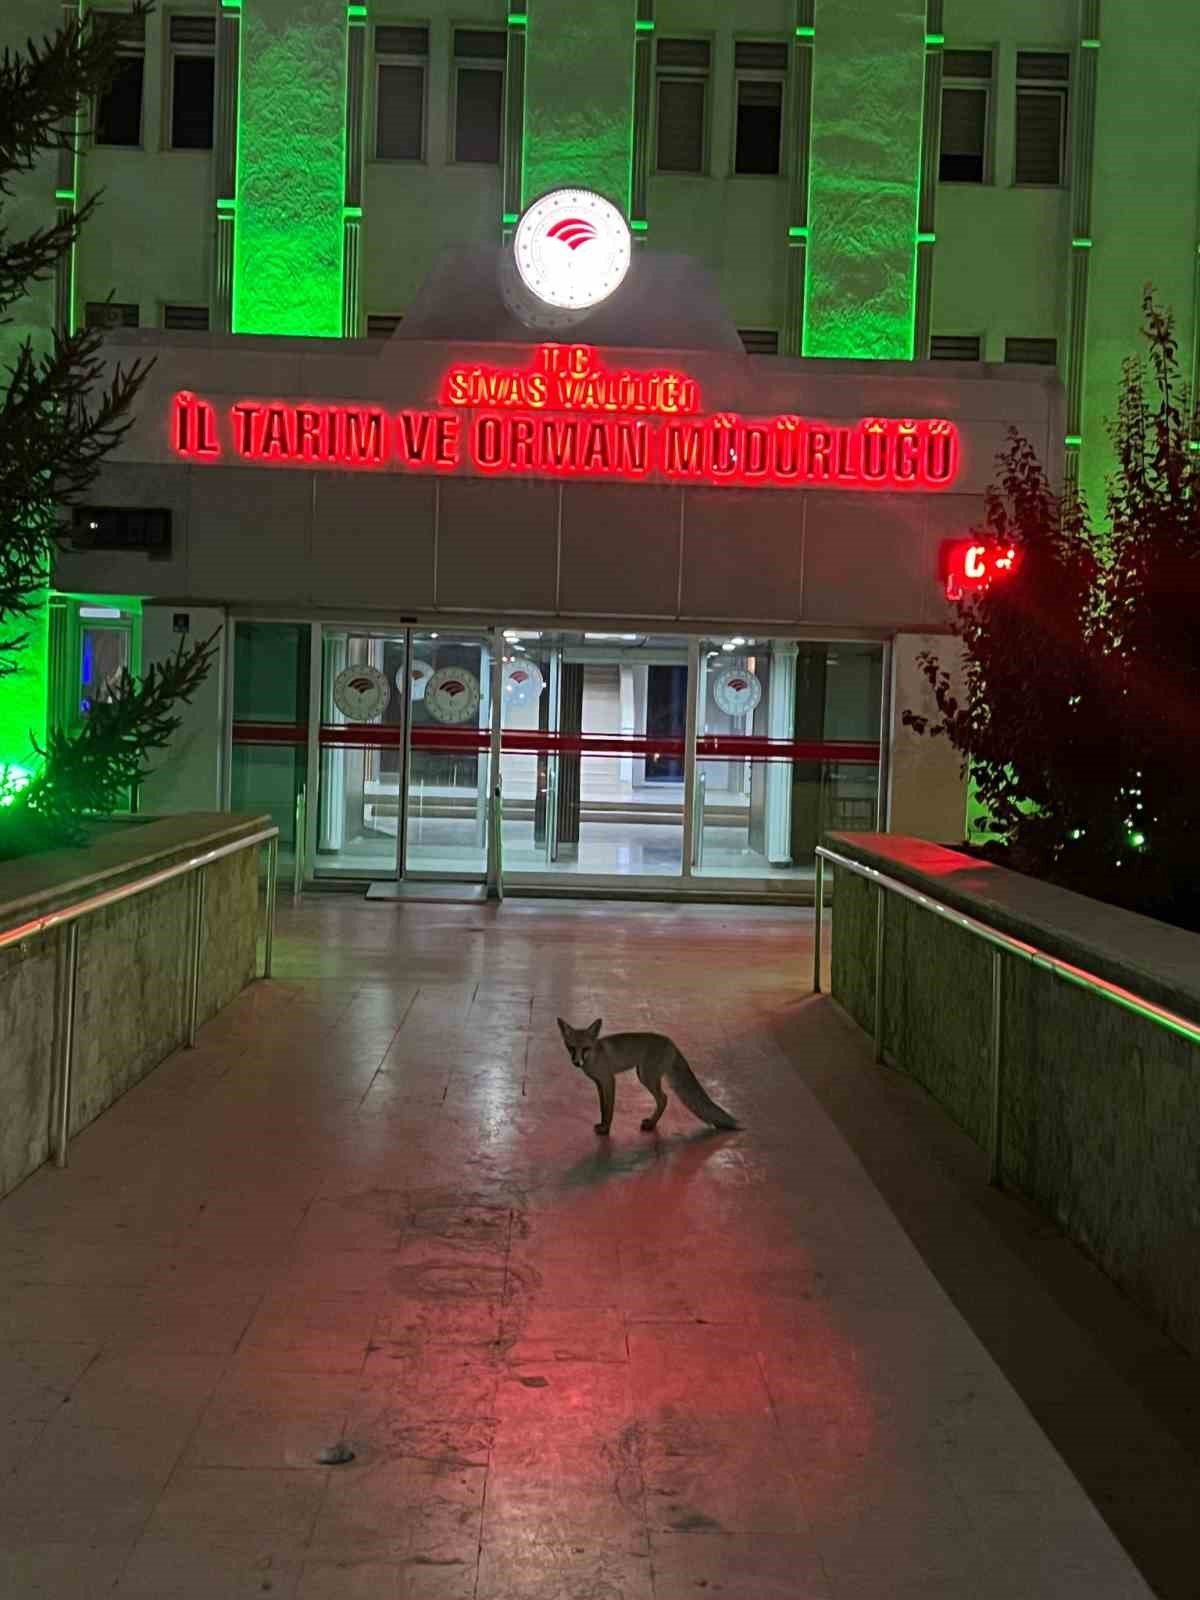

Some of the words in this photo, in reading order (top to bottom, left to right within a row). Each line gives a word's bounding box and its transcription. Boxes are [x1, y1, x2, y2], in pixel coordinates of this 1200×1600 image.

[174, 391, 219, 456] İL
[232, 402, 384, 462] TARIM
[402, 409, 459, 465] VE
[476, 414, 647, 472] ORMAN
[665, 413, 952, 482] MÜDÜRLÜĞÜ
